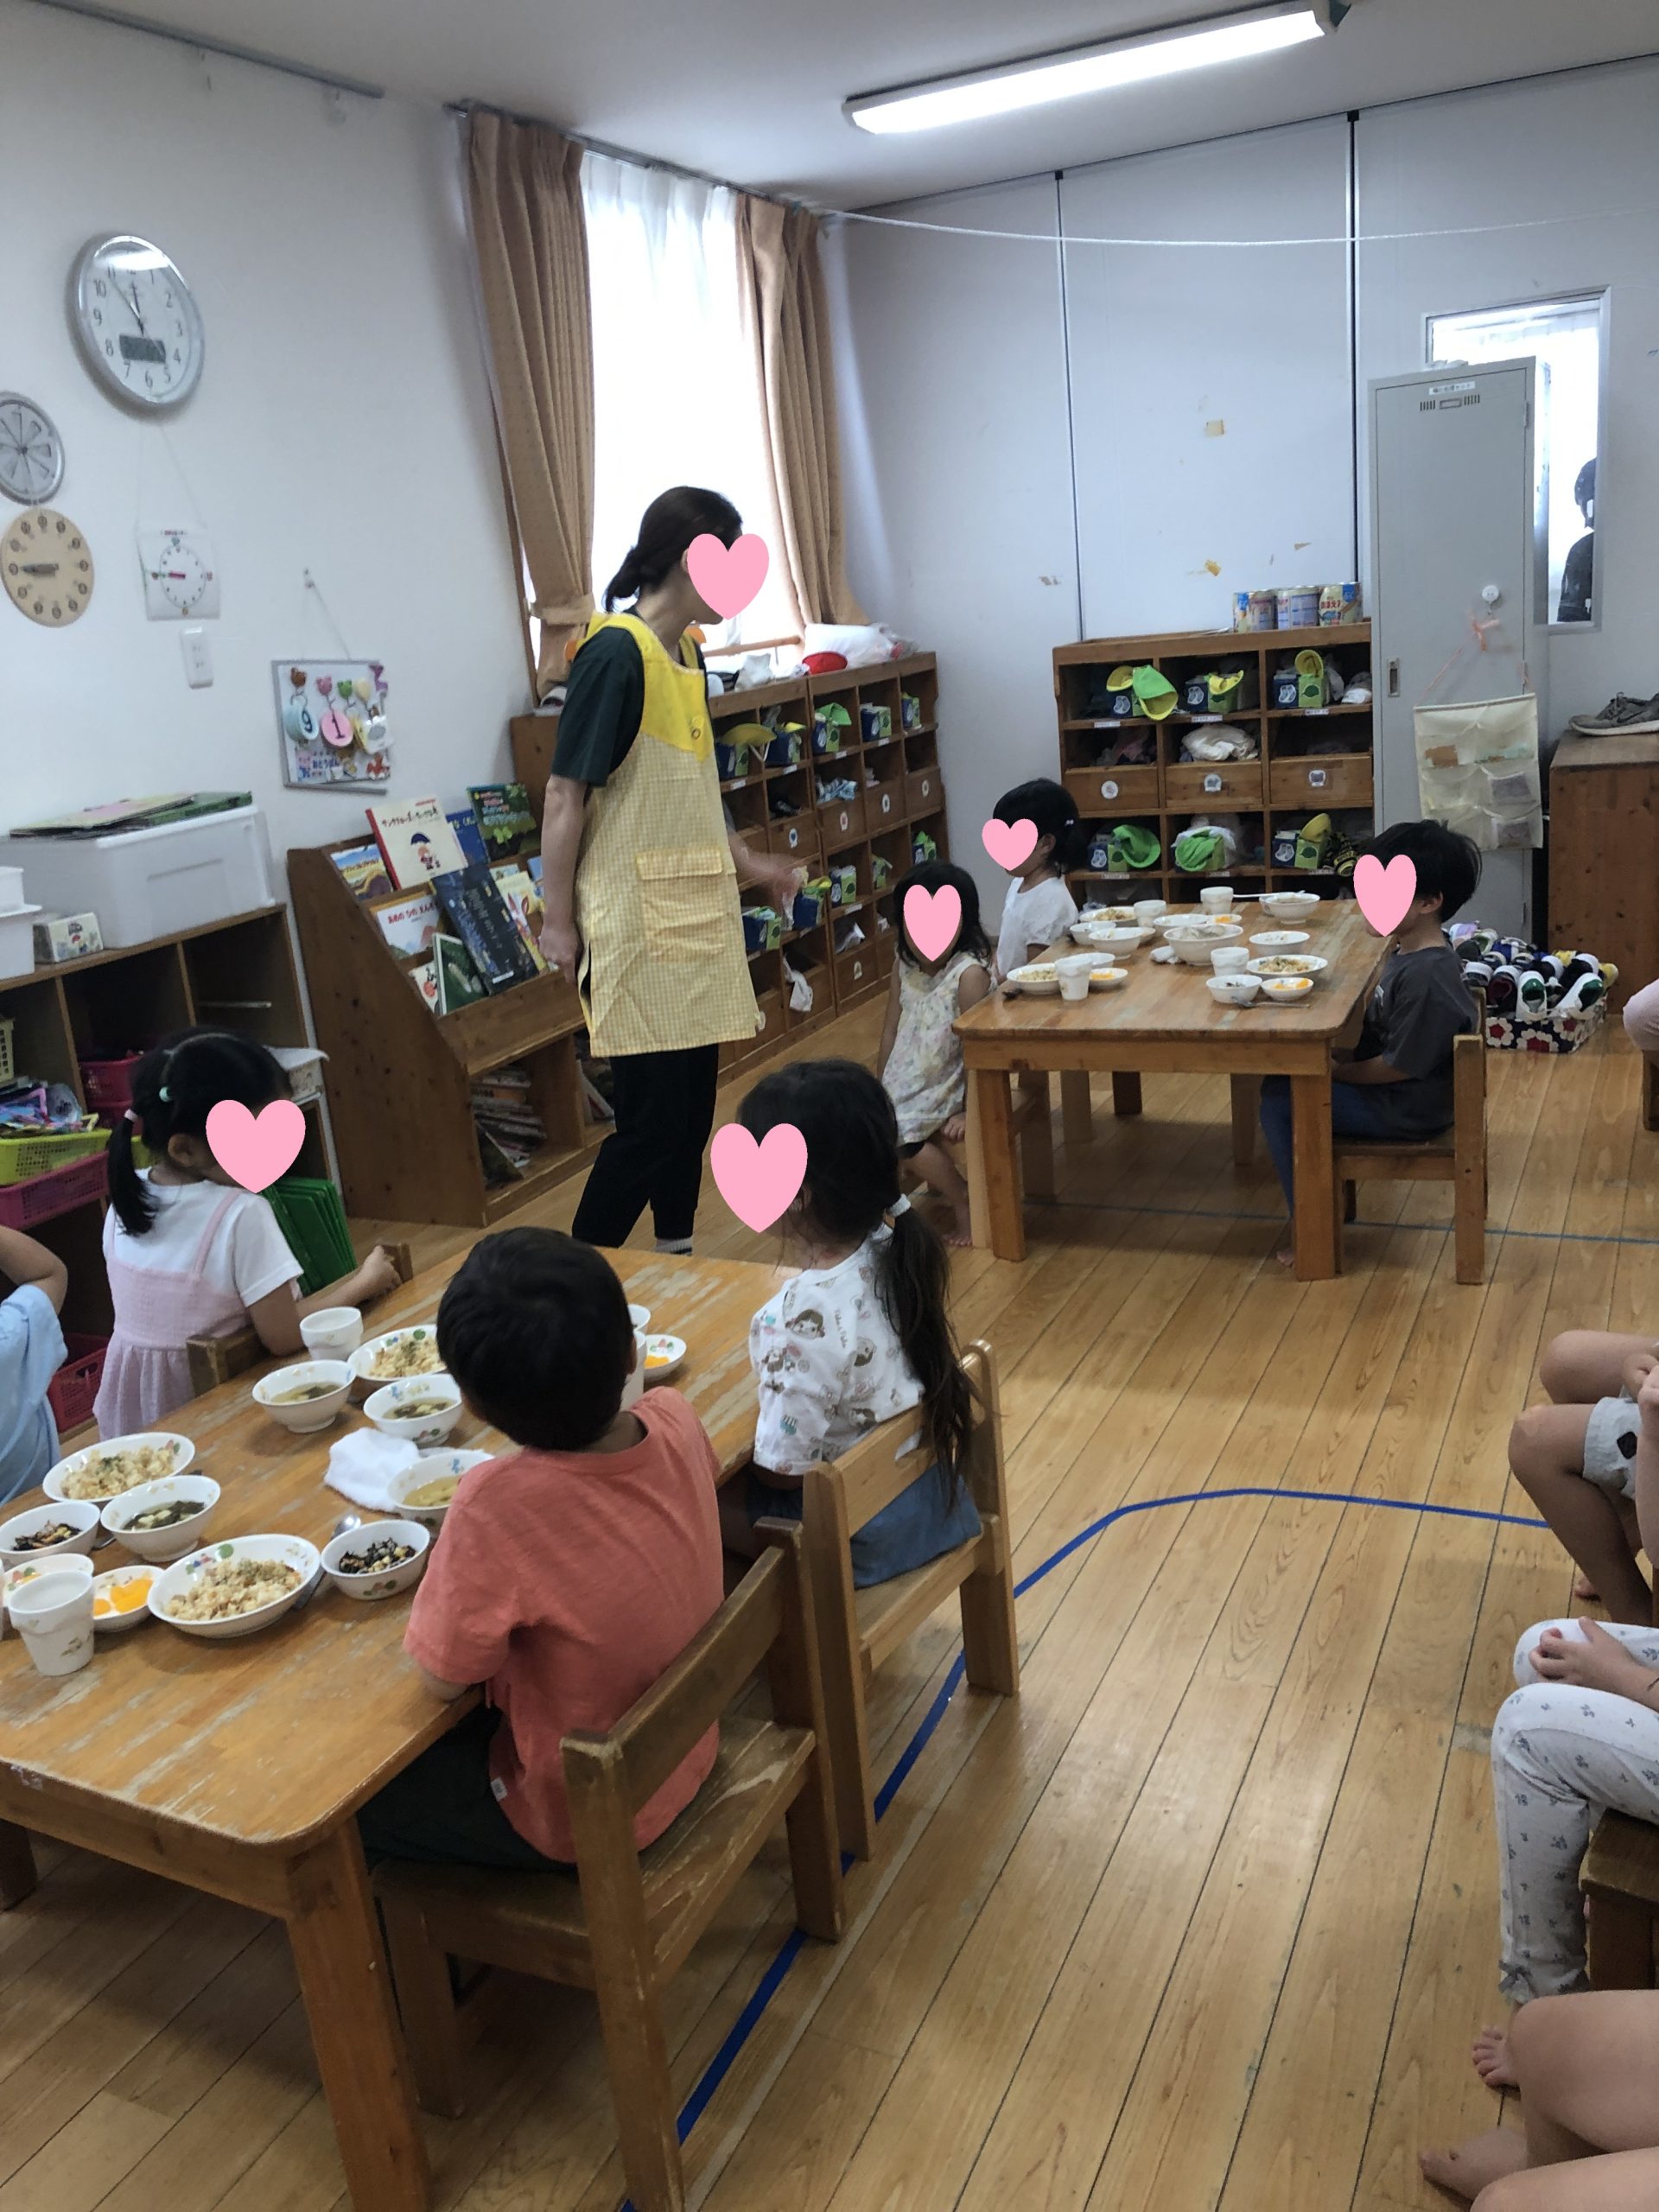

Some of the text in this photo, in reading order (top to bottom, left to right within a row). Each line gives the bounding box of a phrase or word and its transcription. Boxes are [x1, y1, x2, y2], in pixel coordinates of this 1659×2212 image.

[93, 280, 107, 298] 10
[164, 291, 173, 308] 2
[93, 308, 102, 327] 9
[175, 321, 183, 336] 3
[105, 339, 114, 357] 8
[173, 348, 181, 365] 4
[124, 360, 132, 378] 7
[163, 364, 171, 383] 5
[144, 371, 153, 389] 6
[302, 709, 313, 734] 9
[331, 711, 346, 740] 1
